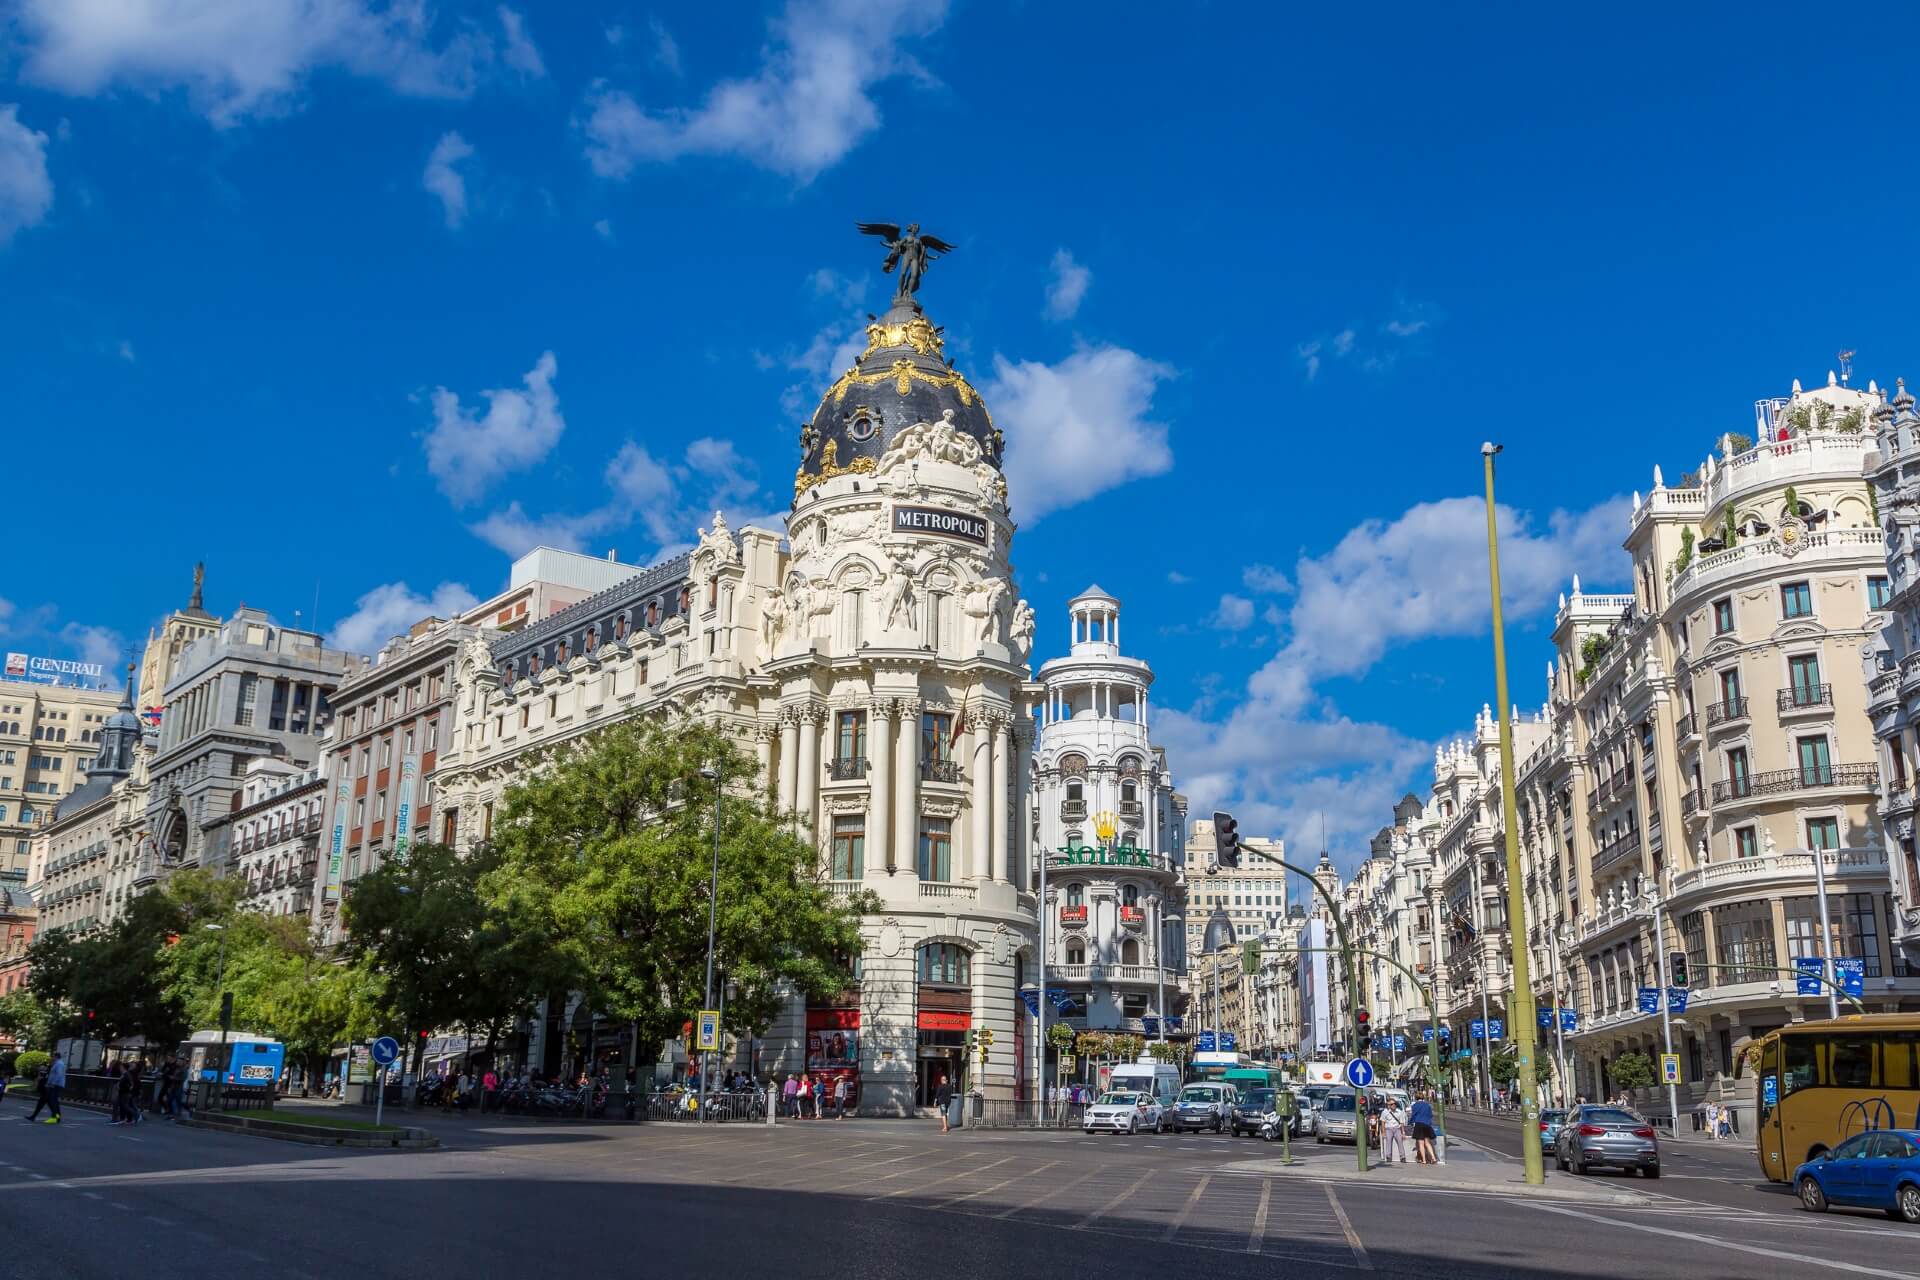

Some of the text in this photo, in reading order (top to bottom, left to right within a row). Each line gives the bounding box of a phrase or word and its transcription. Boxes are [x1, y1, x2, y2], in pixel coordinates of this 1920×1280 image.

[899, 511, 985, 538] METROPOLIS
[30, 656, 104, 677] GENERALI
[397, 803, 409, 834] salida
[332, 825, 343, 854] salida
[1056, 845, 1153, 868] ROLEX
